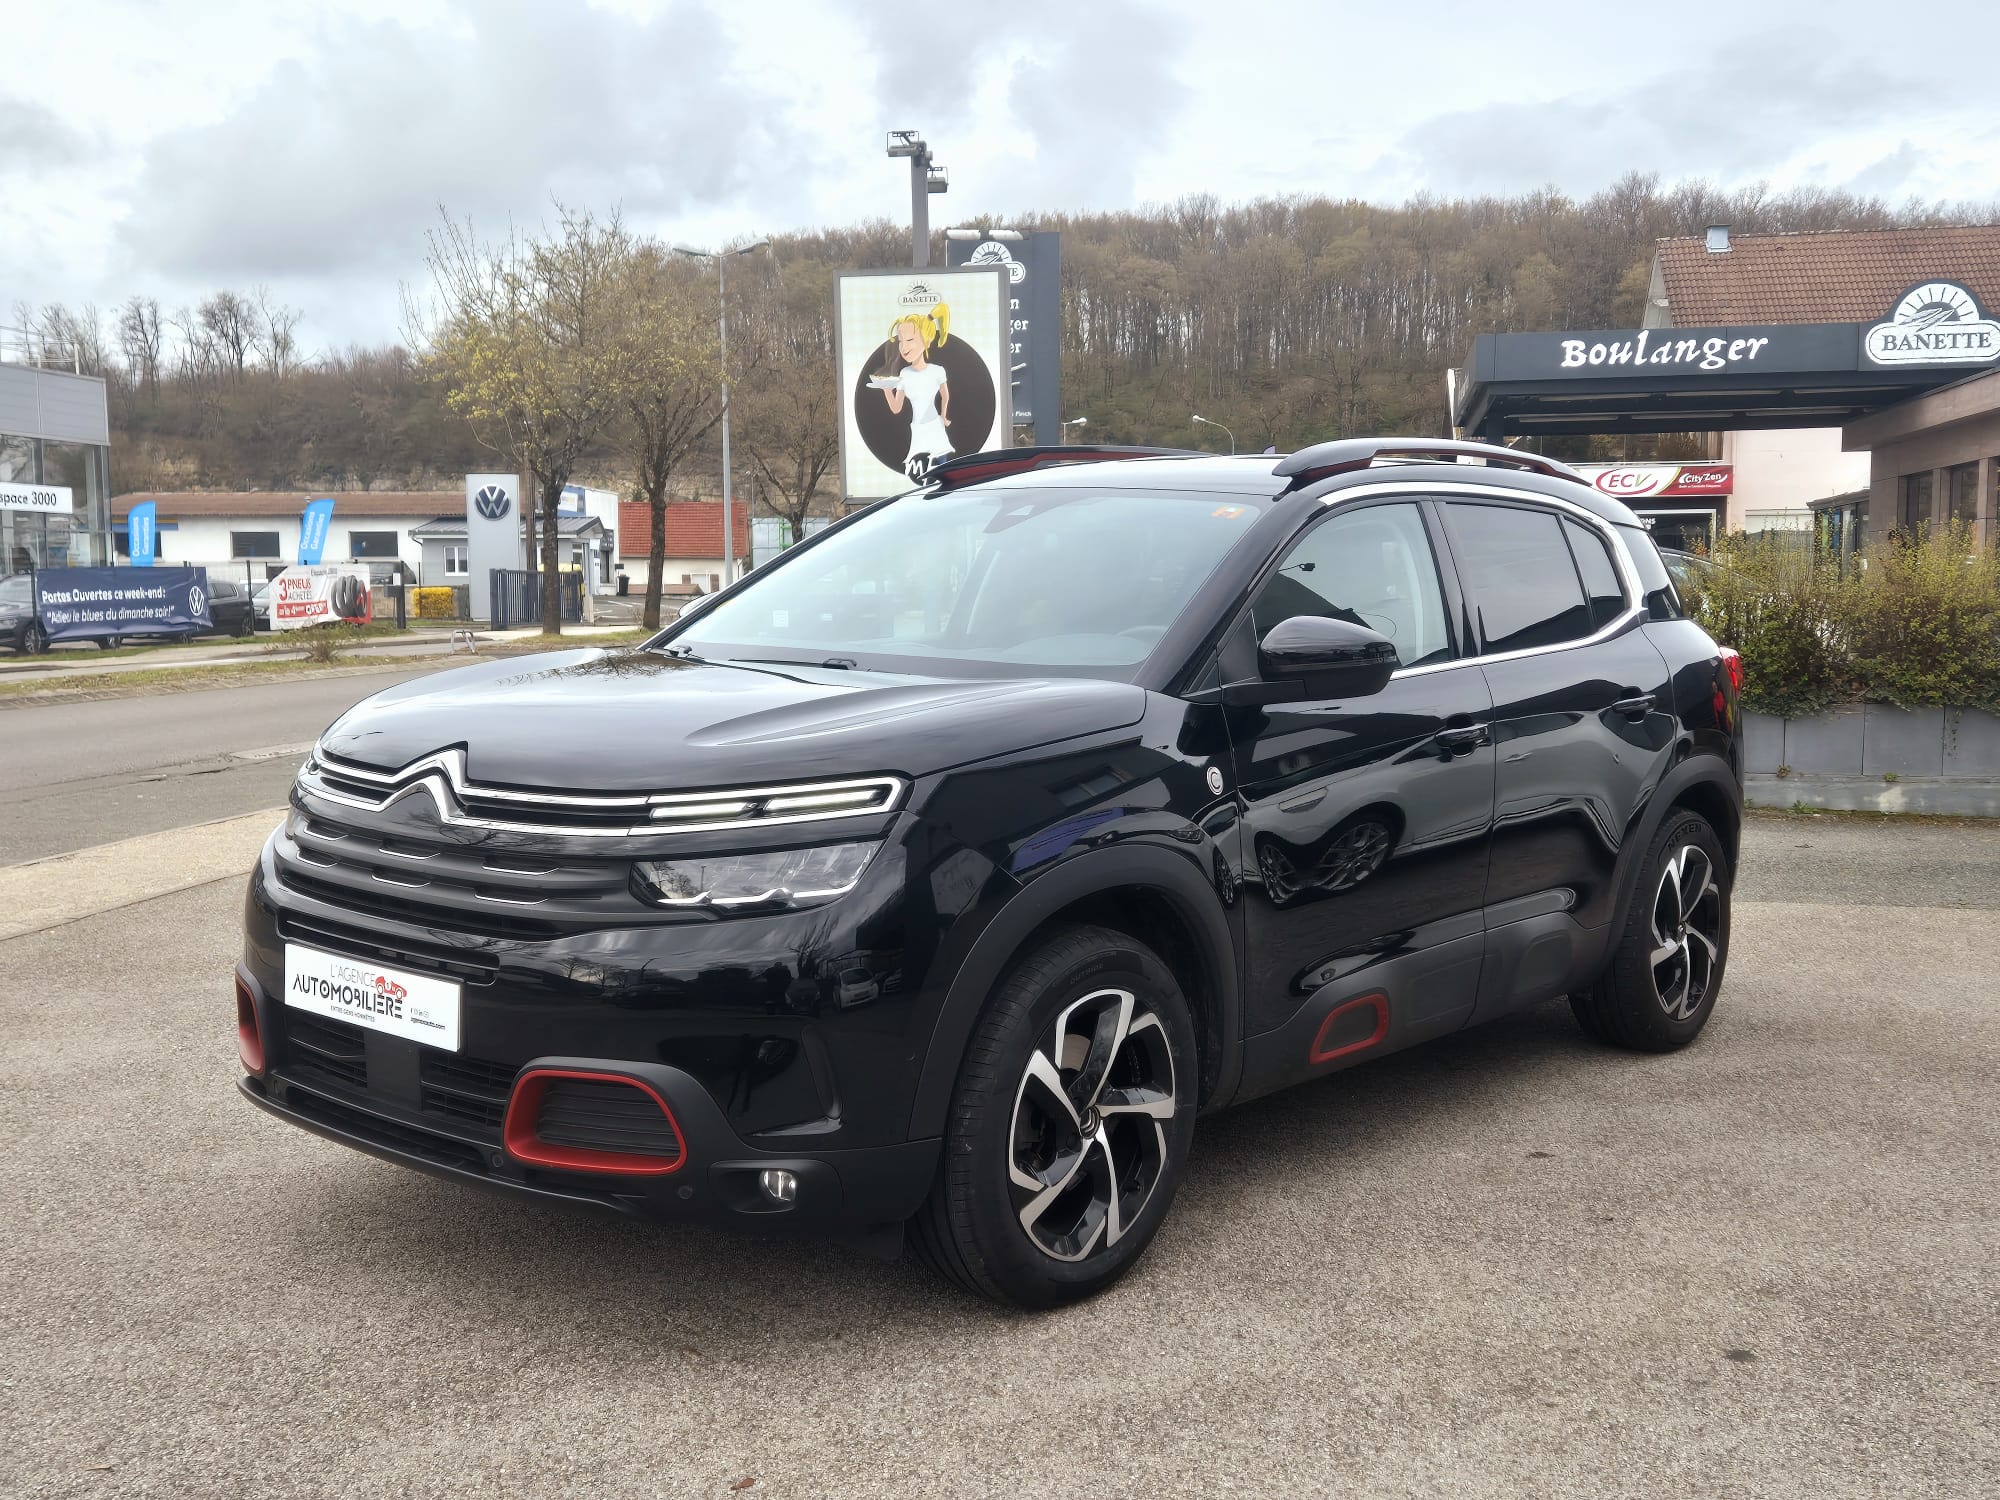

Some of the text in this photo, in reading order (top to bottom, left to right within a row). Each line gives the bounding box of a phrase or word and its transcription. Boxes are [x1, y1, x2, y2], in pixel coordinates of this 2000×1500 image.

[902, 295, 938, 304] BANETTE
[1560, 330, 1769, 370] Boulanger
[1880, 331, 1992, 353] BANETTE
[1608, 473, 1653, 488] ECV
[31, 491, 57, 506] 3000
[42, 590, 71, 604] Portes
[72, 588, 113, 602] Ouvertes
[114, 591, 124, 600] ce
[278, 577, 312, 601] 3 PNEUS
[81, 608, 104, 622] blues
[106, 608, 117, 620] du
[118, 606, 153, 619] dimanche
[1667, 823, 1702, 851] NEXEN
[330, 963, 376, 989] L'AGENCE
